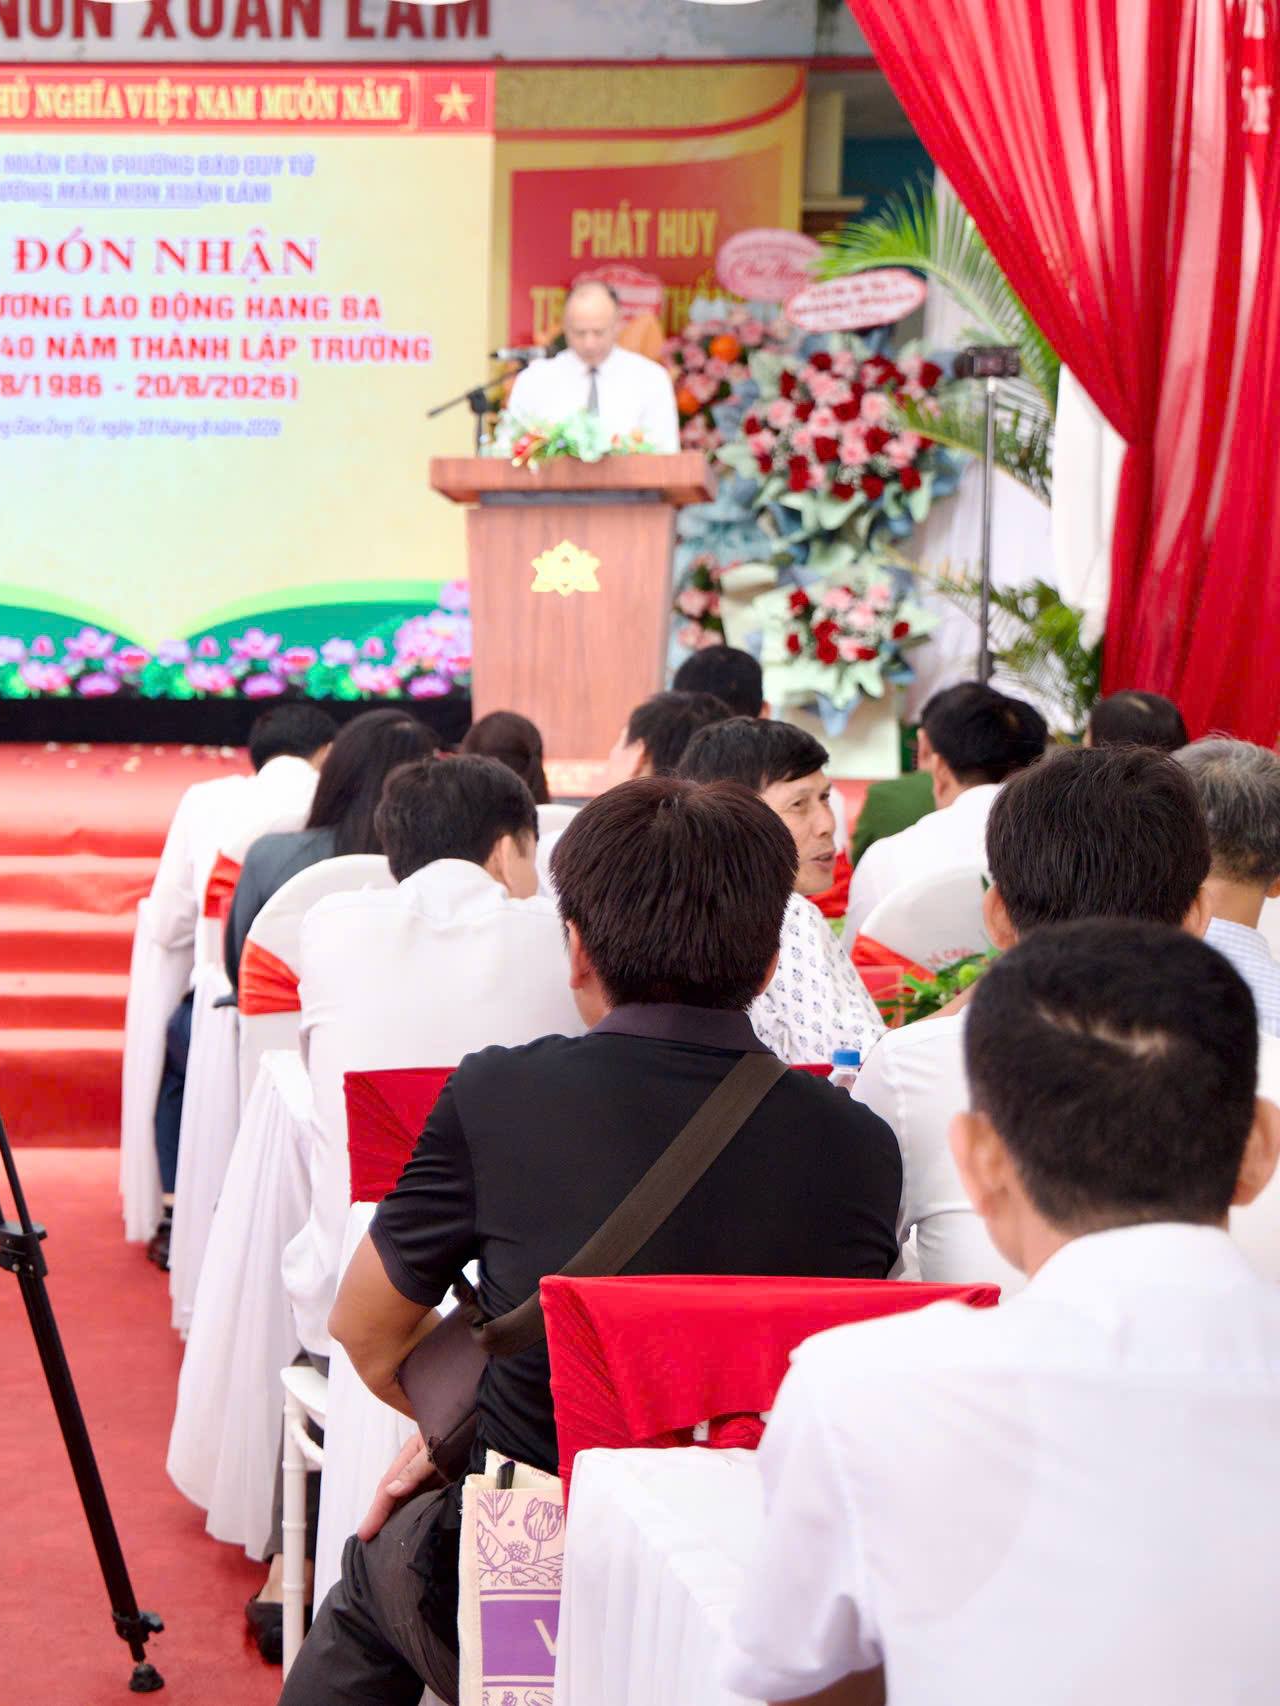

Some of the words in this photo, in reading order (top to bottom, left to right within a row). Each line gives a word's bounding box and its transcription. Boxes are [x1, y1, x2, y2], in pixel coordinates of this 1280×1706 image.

[34, 78, 125, 120] NGHĨA
[126, 76, 193, 126] VIỆT
[195, 84, 258, 121] NAM
[341, 78, 403, 121] NĂM
[571, 199, 651, 258] PHÁT
[657, 208, 718, 257] HUY
[13, 226, 137, 275] ĐÓN
[153, 228, 319, 285] NHẬN
[83, 295, 139, 320] LAO
[150, 291, 235, 326] ĐỘNG
[341, 296, 382, 320] BA
[0, 336, 35, 358] 40
[46, 331, 118, 359] NĂM
[130, 331, 230, 360] THÀNH
[240, 332, 298, 368] LẬP
[311, 331, 433, 361] TRƯỜNG
[136, 374, 299, 400] 20/8/2026)
